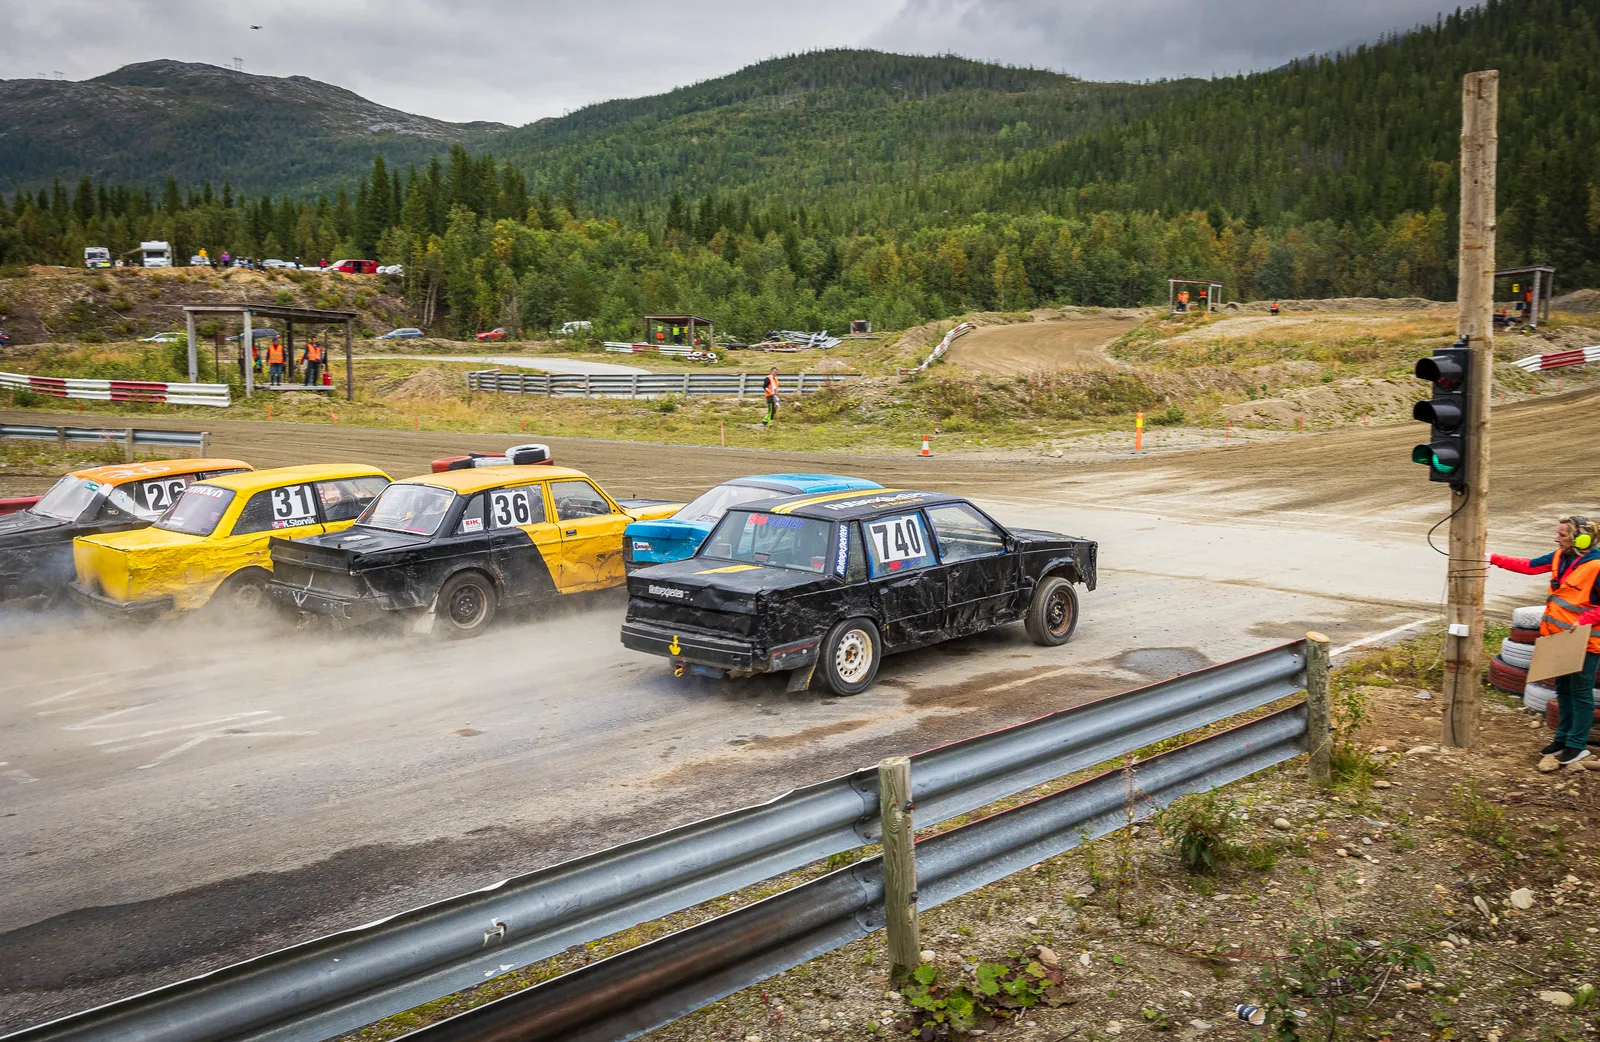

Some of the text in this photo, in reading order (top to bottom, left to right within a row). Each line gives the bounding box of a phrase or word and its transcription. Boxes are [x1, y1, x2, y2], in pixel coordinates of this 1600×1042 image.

[275, 484, 310, 517] 31
[495, 493, 529, 525] 36
[872, 519, 921, 559] 740
